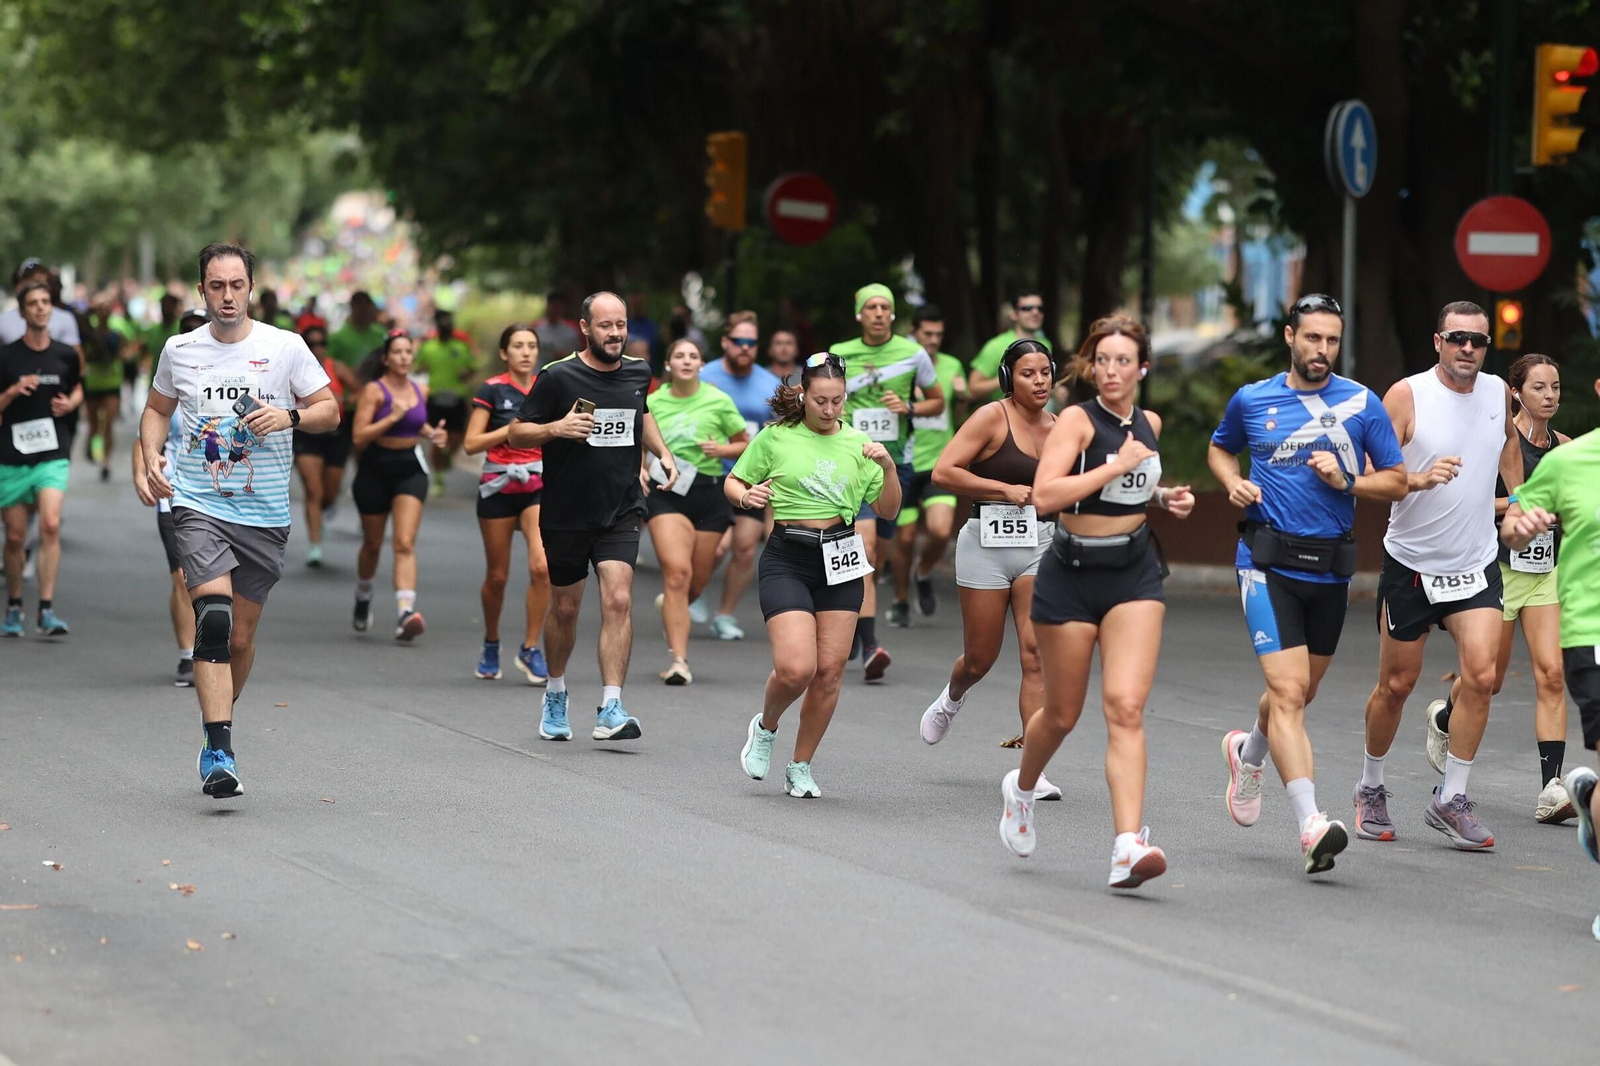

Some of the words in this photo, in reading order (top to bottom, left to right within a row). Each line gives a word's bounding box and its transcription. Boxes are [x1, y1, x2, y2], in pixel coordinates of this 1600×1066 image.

[202, 387, 250, 400] 1107
[591, 421, 625, 435] 529
[860, 420, 891, 431] 912
[1280, 441, 1349, 452] DEPORTIVO
[1122, 472, 1147, 488] 30
[989, 520, 1028, 534] 155
[1518, 545, 1552, 560] 294
[831, 551, 861, 571] 542
[1431, 572, 1476, 589] 489
